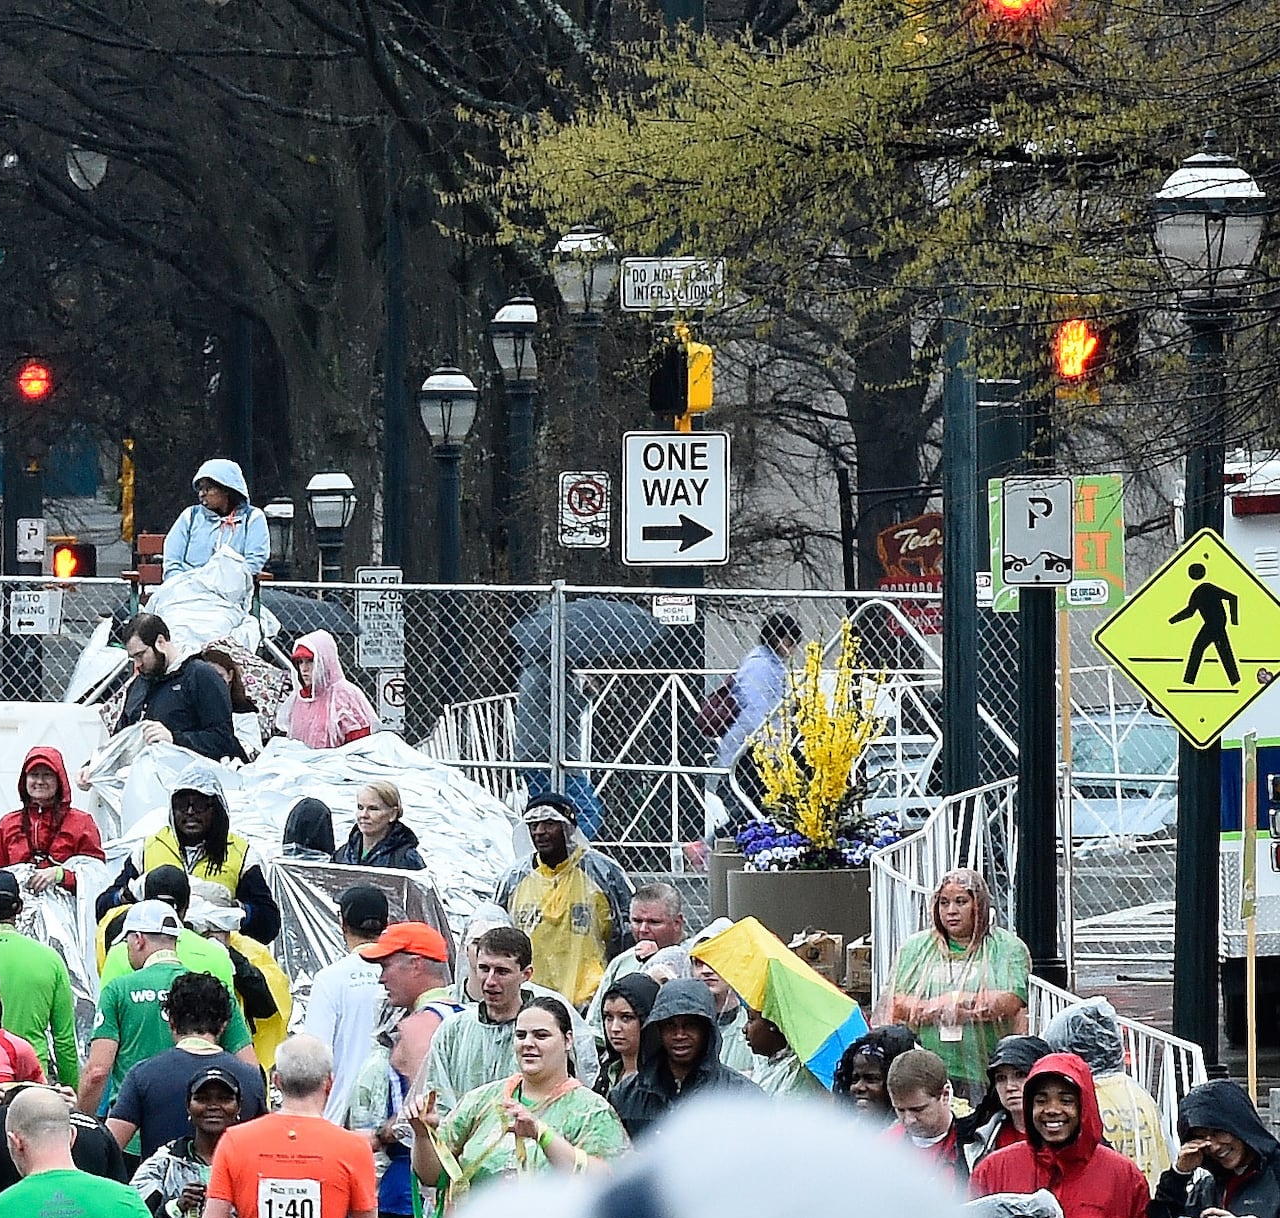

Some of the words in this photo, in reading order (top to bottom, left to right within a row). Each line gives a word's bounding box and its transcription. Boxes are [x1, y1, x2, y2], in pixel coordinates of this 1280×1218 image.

[632, 269, 646, 282] DO
[643, 442, 708, 471] ONE
[642, 478, 709, 506] WAY
[13, 605, 45, 615] KING
[362, 601, 385, 612] 7PM
[663, 606, 684, 614] HIGH
[661, 615, 690, 623] OLTAGE
[130, 989, 156, 1003] we
